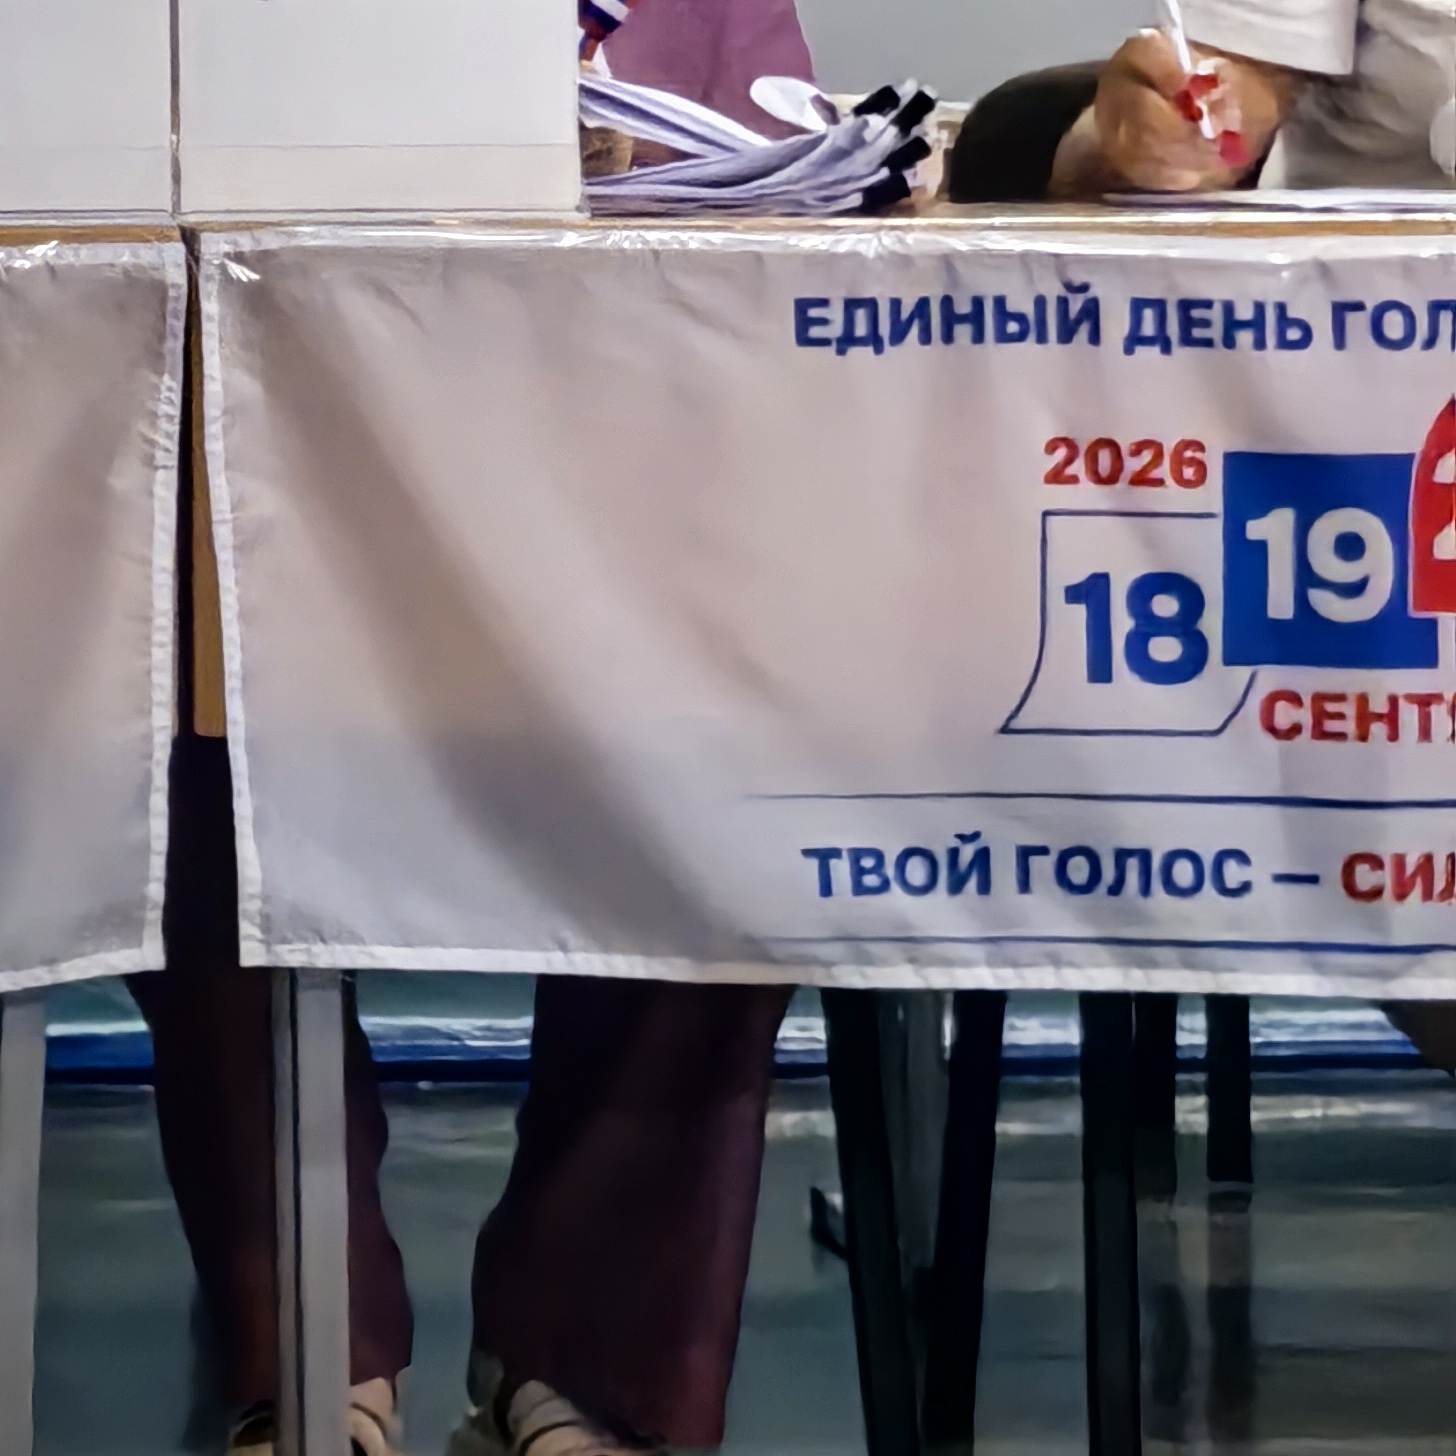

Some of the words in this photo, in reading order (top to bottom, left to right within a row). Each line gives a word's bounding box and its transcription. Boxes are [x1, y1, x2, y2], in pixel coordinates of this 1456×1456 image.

[793, 281, 1102, 356] ЕДИНЫЙ
[1122, 296, 1314, 356] ДЕНЬ
[1042, 436, 1209, 490] 2026
[1063, 571, 1211, 686] 18
[1245, 506, 1394, 623] 19
[1258, 688, 1456, 744] СЕНТ
[800, 831, 993, 898] ТВОЙ
[1014, 844, 1254, 899] ГОЛОС
